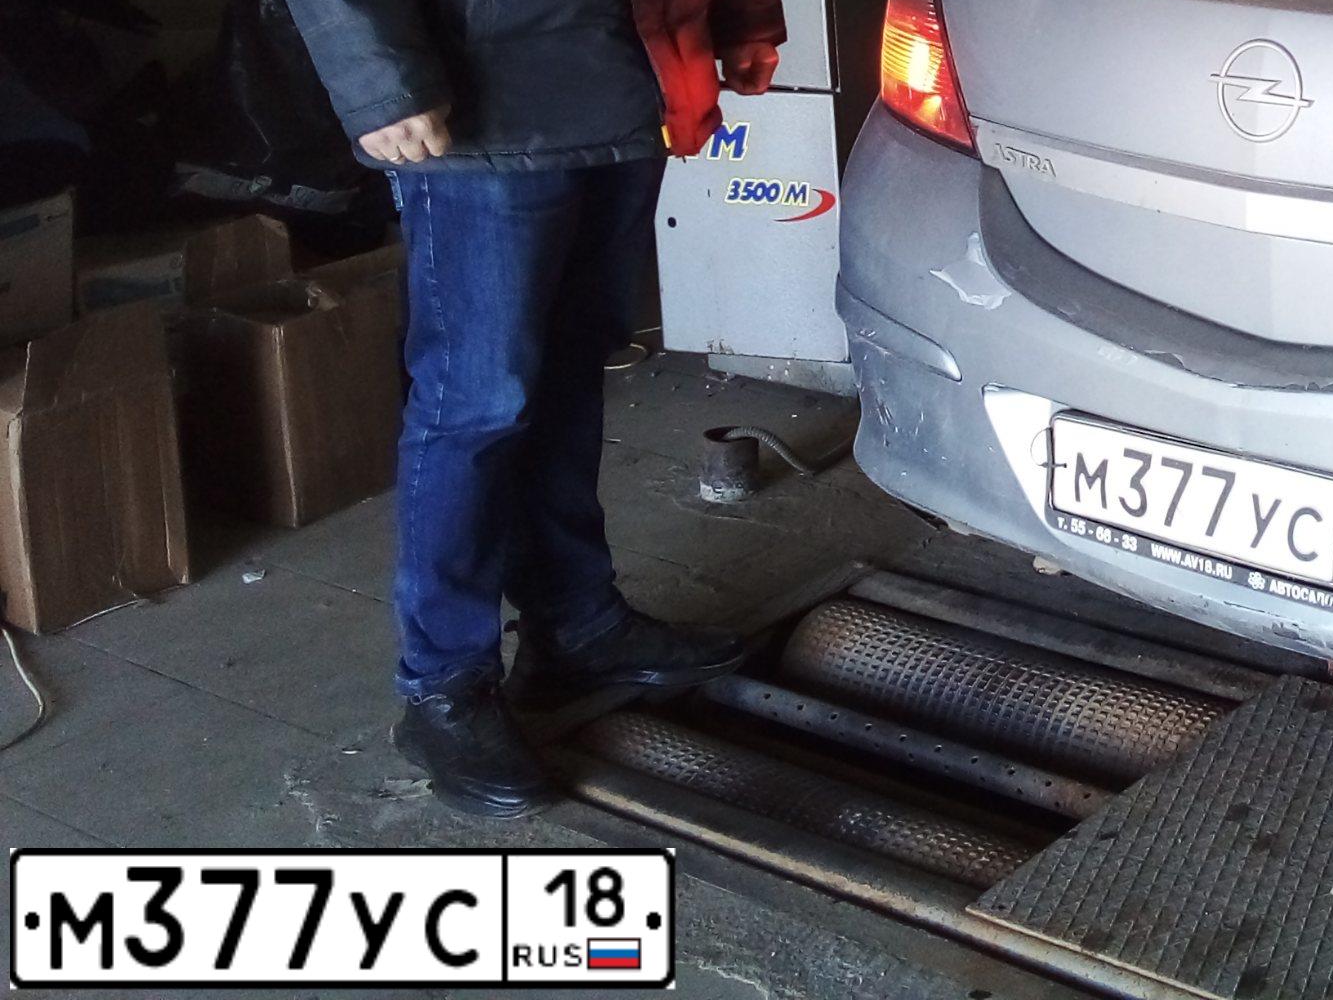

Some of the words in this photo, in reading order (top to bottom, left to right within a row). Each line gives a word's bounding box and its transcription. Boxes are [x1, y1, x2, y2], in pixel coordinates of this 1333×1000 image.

[993, 142, 1057, 178] ASTRA
[726, 179, 781, 202] 3500
[782, 182, 809, 204] М
[1073, 447, 1324, 563] М377УС
